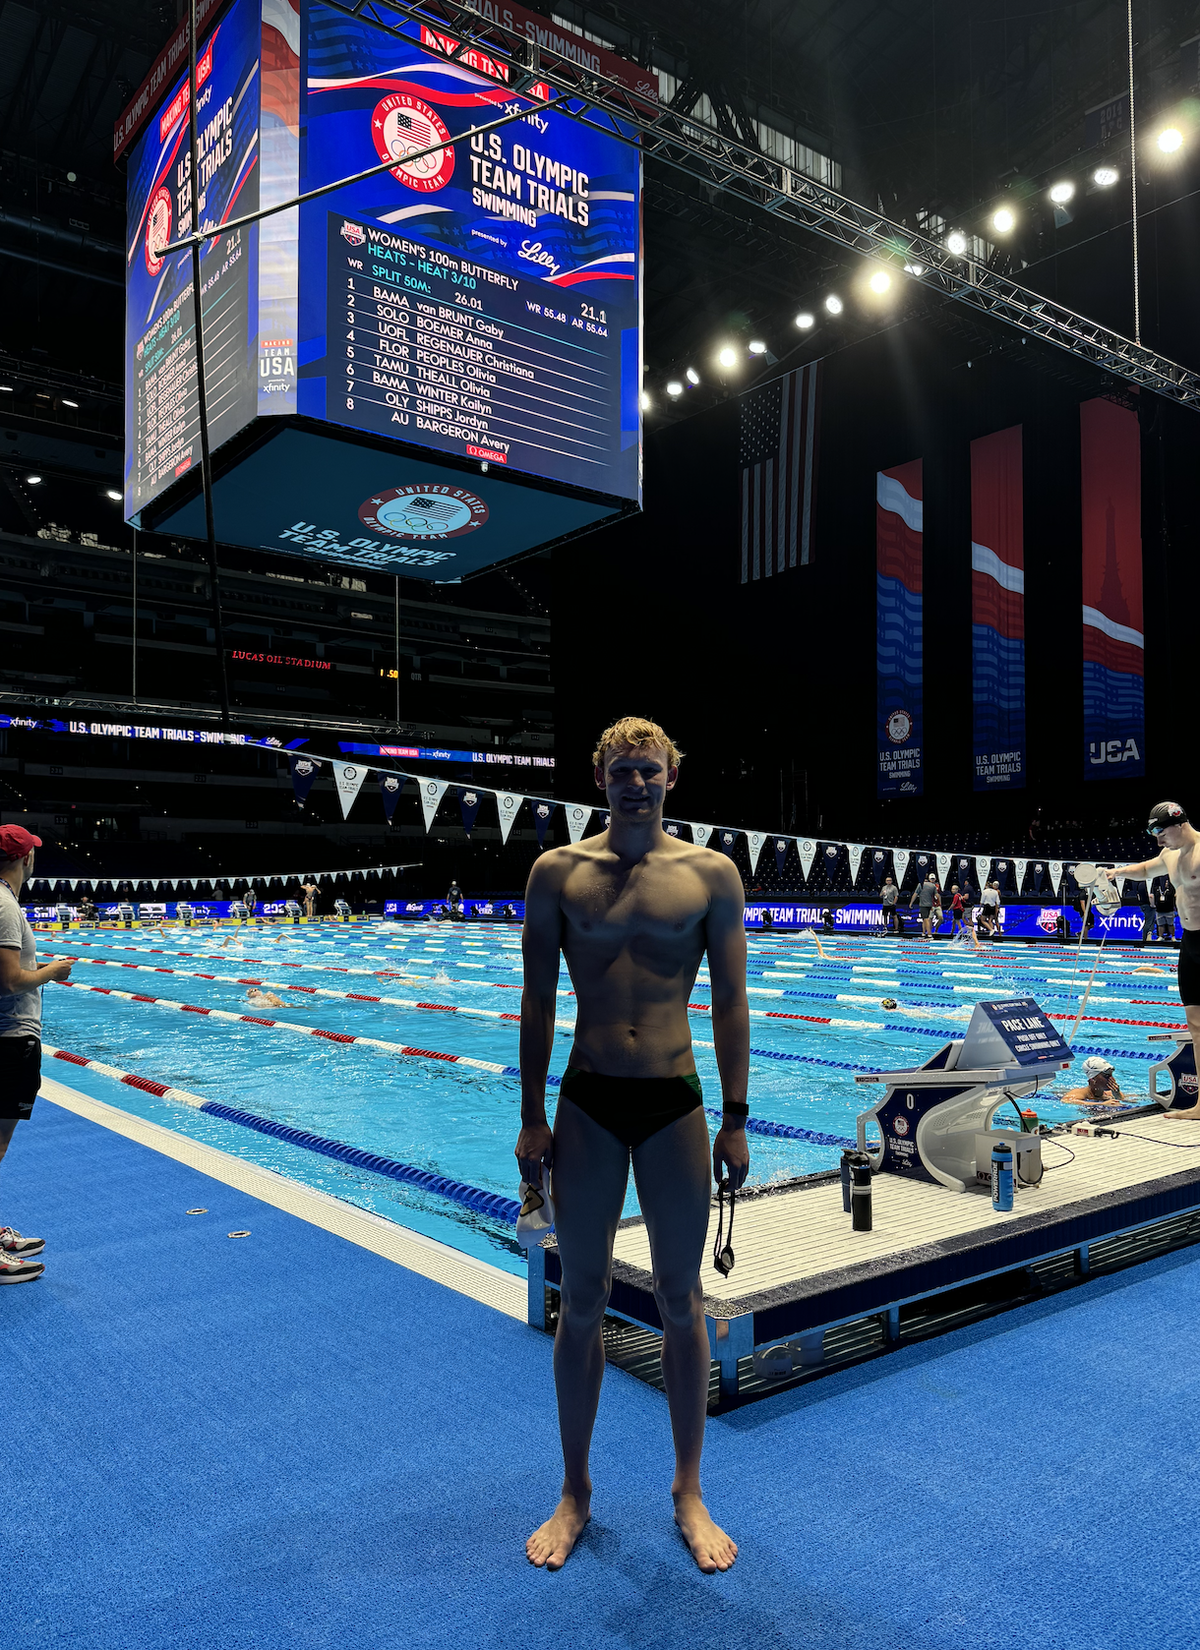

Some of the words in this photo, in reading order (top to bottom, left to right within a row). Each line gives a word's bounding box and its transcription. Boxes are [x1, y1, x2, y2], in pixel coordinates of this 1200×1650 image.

[525, 20, 601, 74] SWIMMING
[150, 57, 167, 97] TEAM
[381, 95, 413, 112] UNITED
[416, 101, 446, 135] STATES
[201, 128, 233, 187] TRIALS
[470, 124, 507, 164] U.S.
[513, 143, 589, 198] OLYMPIC
[423, 175, 445, 190] TEAM
[469, 154, 522, 200] TEAM
[527, 178, 589, 227] TRIALS
[472, 187, 537, 228] SWIMMING
[346, 222, 361, 235] USA
[471, 228, 500, 245] presented
[499, 236, 508, 248] by
[226, 228, 241, 255] 21.1
[367, 227, 426, 259] WOMEN'S
[429, 250, 459, 271] 100m
[461, 261, 519, 292] BUTTERFLY
[368, 242, 407, 267] HEATS
[418, 259, 449, 281] HEAT
[451, 270, 477, 290] 3/10
[517, 239, 561, 276] Lilly
[347, 257, 364, 271] WR
[372, 264, 402, 283] SPLIT
[404, 275, 432, 293] 50M:
[454, 291, 483, 311] 26.01
[347, 277, 355, 290] 1
[373, 285, 410, 308] BAMA
[416, 301, 437, 316] van
[438, 306, 474, 328] BRUNT
[475, 320, 504, 339] Gaby
[526, 300, 541, 315] WR
[543, 308, 567, 324] 55.48
[580, 302, 607, 324] 21.1
[346, 293, 355, 307] 2
[376, 304, 410, 324] SOLO
[416, 317, 464, 341] BOEMER
[465, 332, 493, 350] Anna
[571, 318, 584, 330] AR
[586, 322, 608, 338] 55.64
[264, 347, 290, 357] TEAM
[346, 311, 355, 325] 3
[378, 321, 410, 342] UOFL
[416, 332, 483, 363] REGENAUER
[485, 354, 535, 380] Christiana
[346, 329, 355, 342] 4
[379, 338, 409, 358] FLOR
[416, 349, 464, 373] PEOPLES
[466, 365, 497, 383] Olivia
[260, 357, 295, 378] USA
[346, 345, 355, 359] 5
[374, 354, 409, 375] TAMU
[416, 365, 458, 388] THEALL
[460, 379, 491, 398] Olivia
[263, 382, 290, 394] xfinity
[346, 363, 355, 376] 6
[373, 371, 409, 392] BAMA
[416, 382, 458, 404] WINTER
[460, 396, 492, 415] Kailyn
[346, 380, 355, 393] 7
[385, 392, 409, 409] OLY
[416, 400, 453, 419] SHIPPS
[454, 410, 489, 430] Jordyn
[346, 397, 355, 410] 8
[391, 411, 409, 426] AU
[416, 416, 479, 443] BARGERON
[480, 436, 510, 454] Avery
[478, 450, 505, 463] OMEGA
[395, 485, 449, 496] UNITED
[453, 489, 486, 514] STATES
[363, 516, 405, 539] OLYMPIC
[278, 529, 352, 554] TEAM
[356, 549, 442, 566] TRIALS
[290, 521, 341, 543] U.S.
[348, 537, 457, 561] OLYMPIC
[232, 650, 264, 662] LUCAS
[266, 654, 283, 664] OIL
[285, 656, 331, 670] STADIUM
[9, 717, 37, 729] xfinity
[70, 721, 88, 734] U.S.
[90, 723, 132, 737] OLYMPIC
[134, 726, 160, 739] TEAM
[162, 727, 195, 741] TRIALS
[433, 750, 450, 759] xfinity
[472, 752, 485, 763] U.S.
[486, 753, 513, 765] OLYMPIC
[514, 755, 531, 766] TEAM
[532, 756, 556, 767] TRIALS
[879, 752, 891, 761] U.S.
[892, 748, 921, 760] OLYMPIC
[975, 755, 989, 765] U.S.
[990, 751, 1021, 764] OLYMPIC
[1089, 738, 1140, 764] USA
[879, 762, 897, 772] TEAM
[897, 759, 921, 769] TRIALS
[975, 766, 995, 776] TEAM
[996, 762, 1022, 774] TRIALS
[900, 781, 918, 793] Lilly
[986, 774, 1011, 783] SWIMMING
[769, 907, 794, 922] TEAM
[1099, 914, 1146, 932] xfinity
[1001, 1018, 1026, 1032] PACE
[1021, 1016, 1045, 1030] LANE
